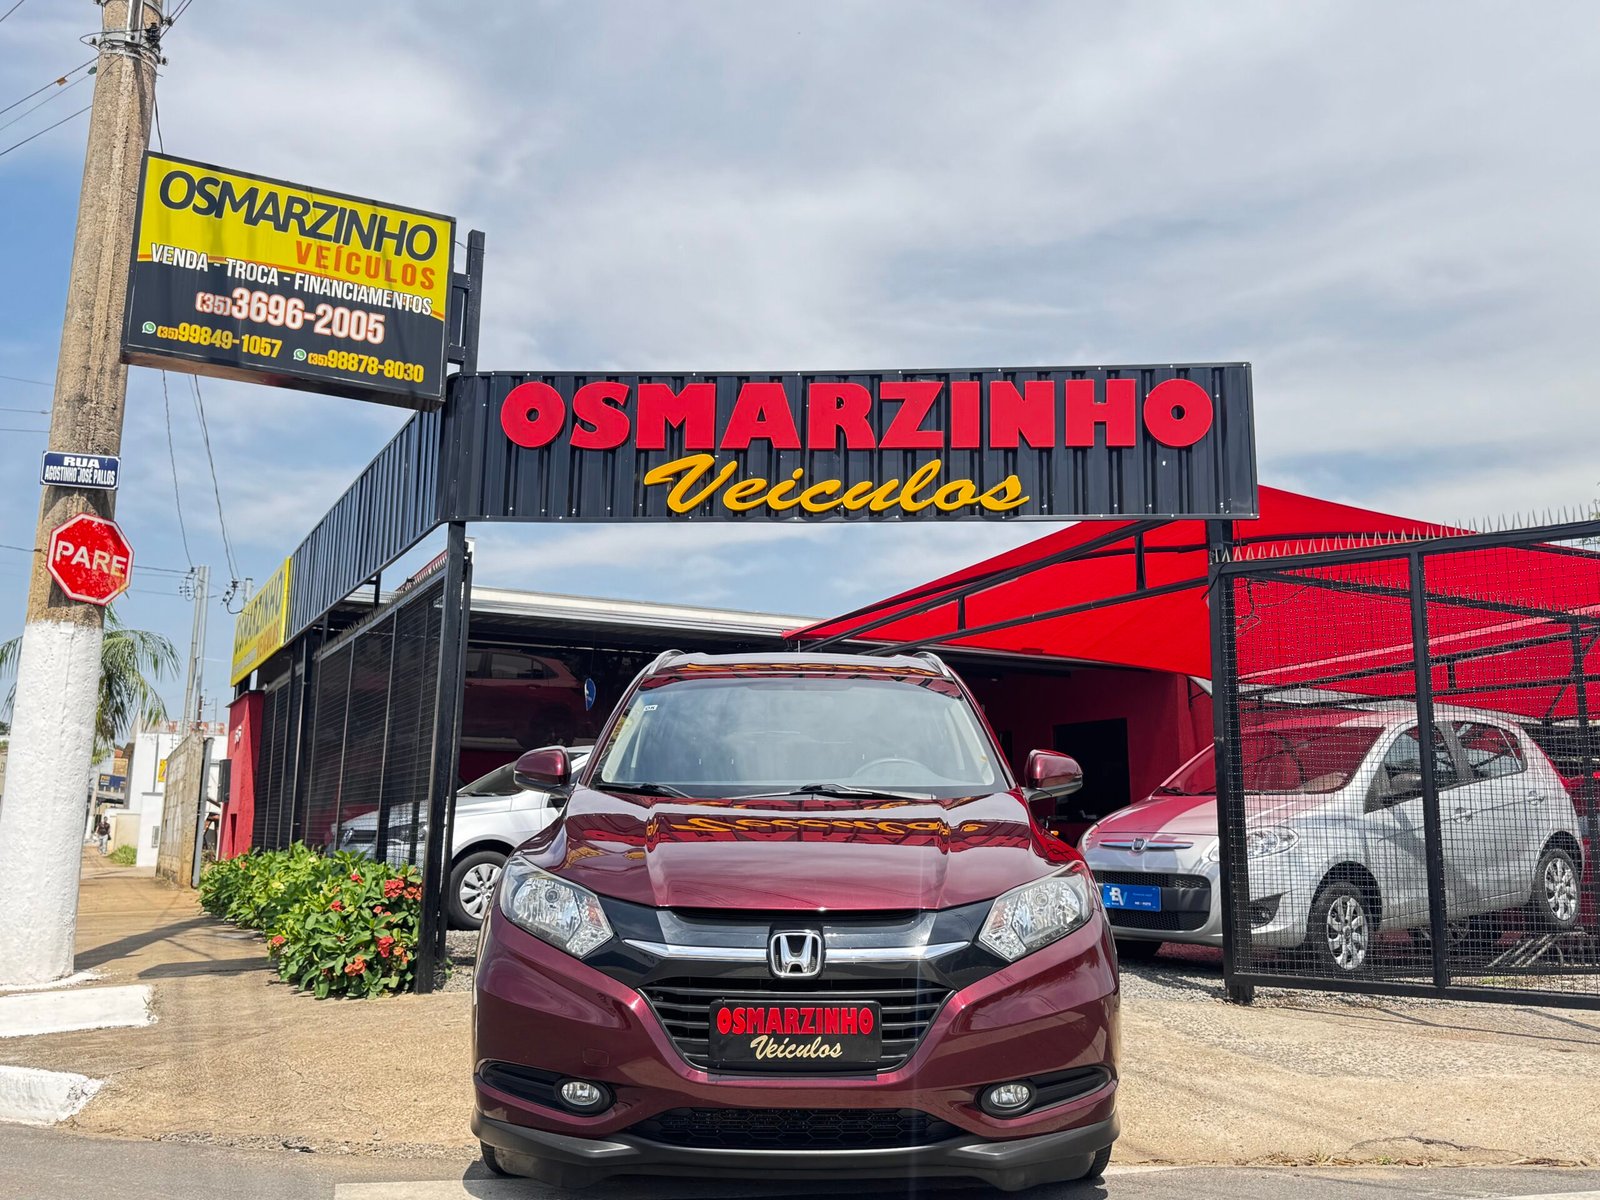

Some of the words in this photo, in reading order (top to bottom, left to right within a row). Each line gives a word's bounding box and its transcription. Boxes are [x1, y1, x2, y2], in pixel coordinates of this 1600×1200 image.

[159, 170, 438, 262] OSMARZINHO
[151, 243, 209, 272] VENDA
[226, 258, 279, 286] TROCA
[294, 272, 433, 315] FINANCIAMENTOS
[296, 240, 436, 290] VEÍCULOS
[195, 287, 386, 344] (35)3696-2005
[157, 322, 282, 358] (35)99849-1057
[308, 349, 424, 383] (35)98878-8030
[501, 378, 1214, 450] OSMARZINHO
[44, 465, 77, 482] AGOSTINHO
[63, 456, 100, 469] RUA
[55, 540, 127, 578] PARE
[717, 1007, 874, 1035] OSMARZINHO
